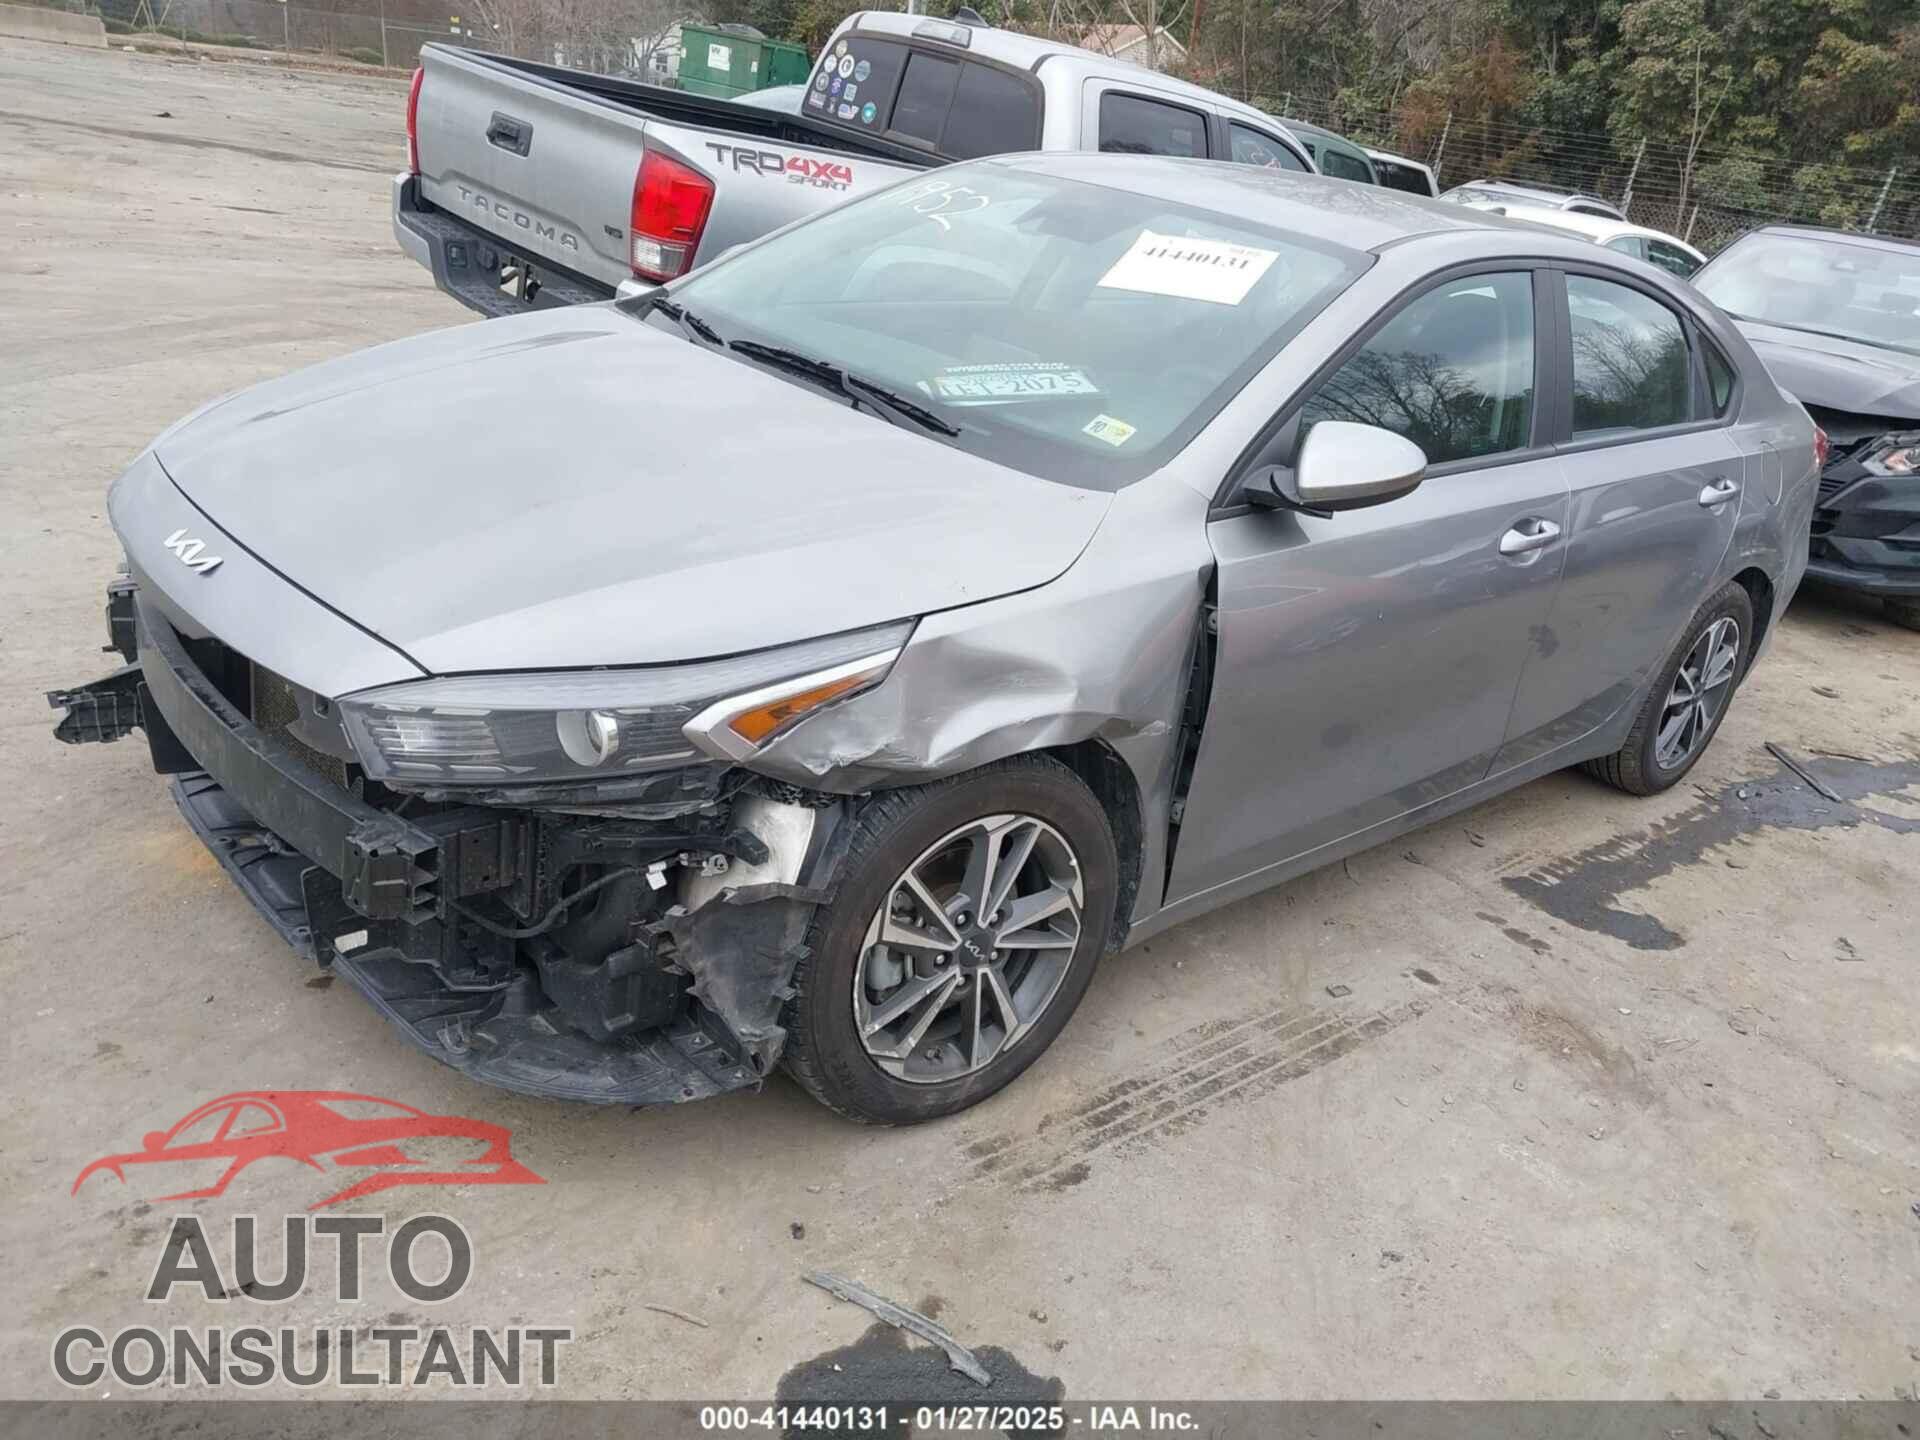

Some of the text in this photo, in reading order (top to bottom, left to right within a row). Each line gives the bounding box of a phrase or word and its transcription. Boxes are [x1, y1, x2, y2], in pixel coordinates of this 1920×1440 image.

[705, 142, 785, 176] TRD
[788, 174, 849, 191] SPORT
[457, 185, 579, 250] TACOMA
